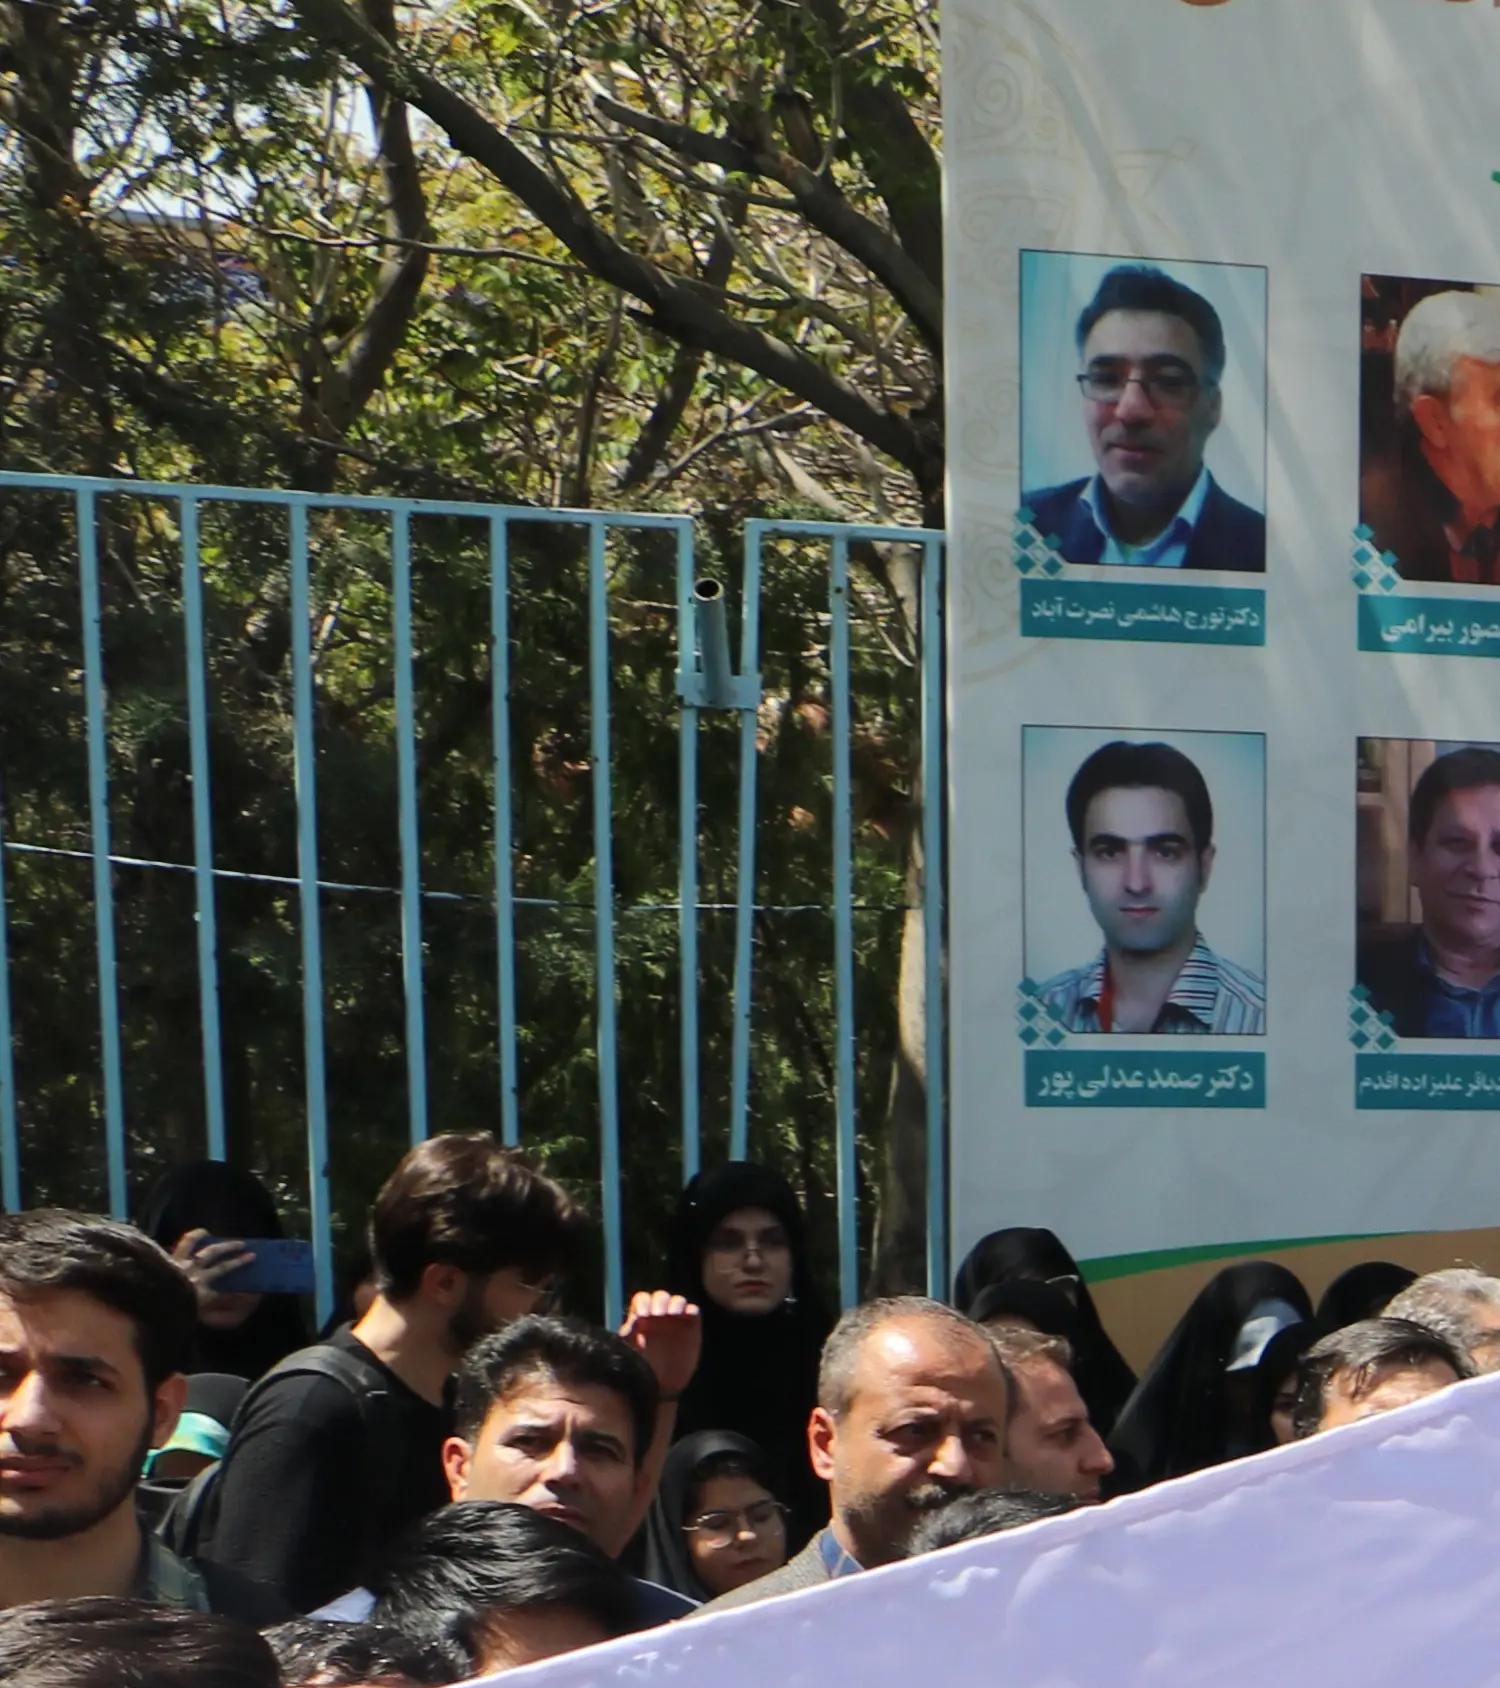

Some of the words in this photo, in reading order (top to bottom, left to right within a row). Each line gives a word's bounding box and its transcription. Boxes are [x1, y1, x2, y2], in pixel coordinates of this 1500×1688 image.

[1030, 596, 1064, 622] آباد
[1065, 601, 1116, 626] نصرت
[1116, 602, 1184, 628] هاشمی
[1183, 606, 1226, 631] تورج
[1225, 606, 1261, 631] دکتر
[1380, 612, 1455, 644] بیرامی
[1146, 1067, 1204, 1090] صمد
[1203, 1063, 1254, 1098] دکتر
[1357, 1070, 1400, 1097] اقدم
